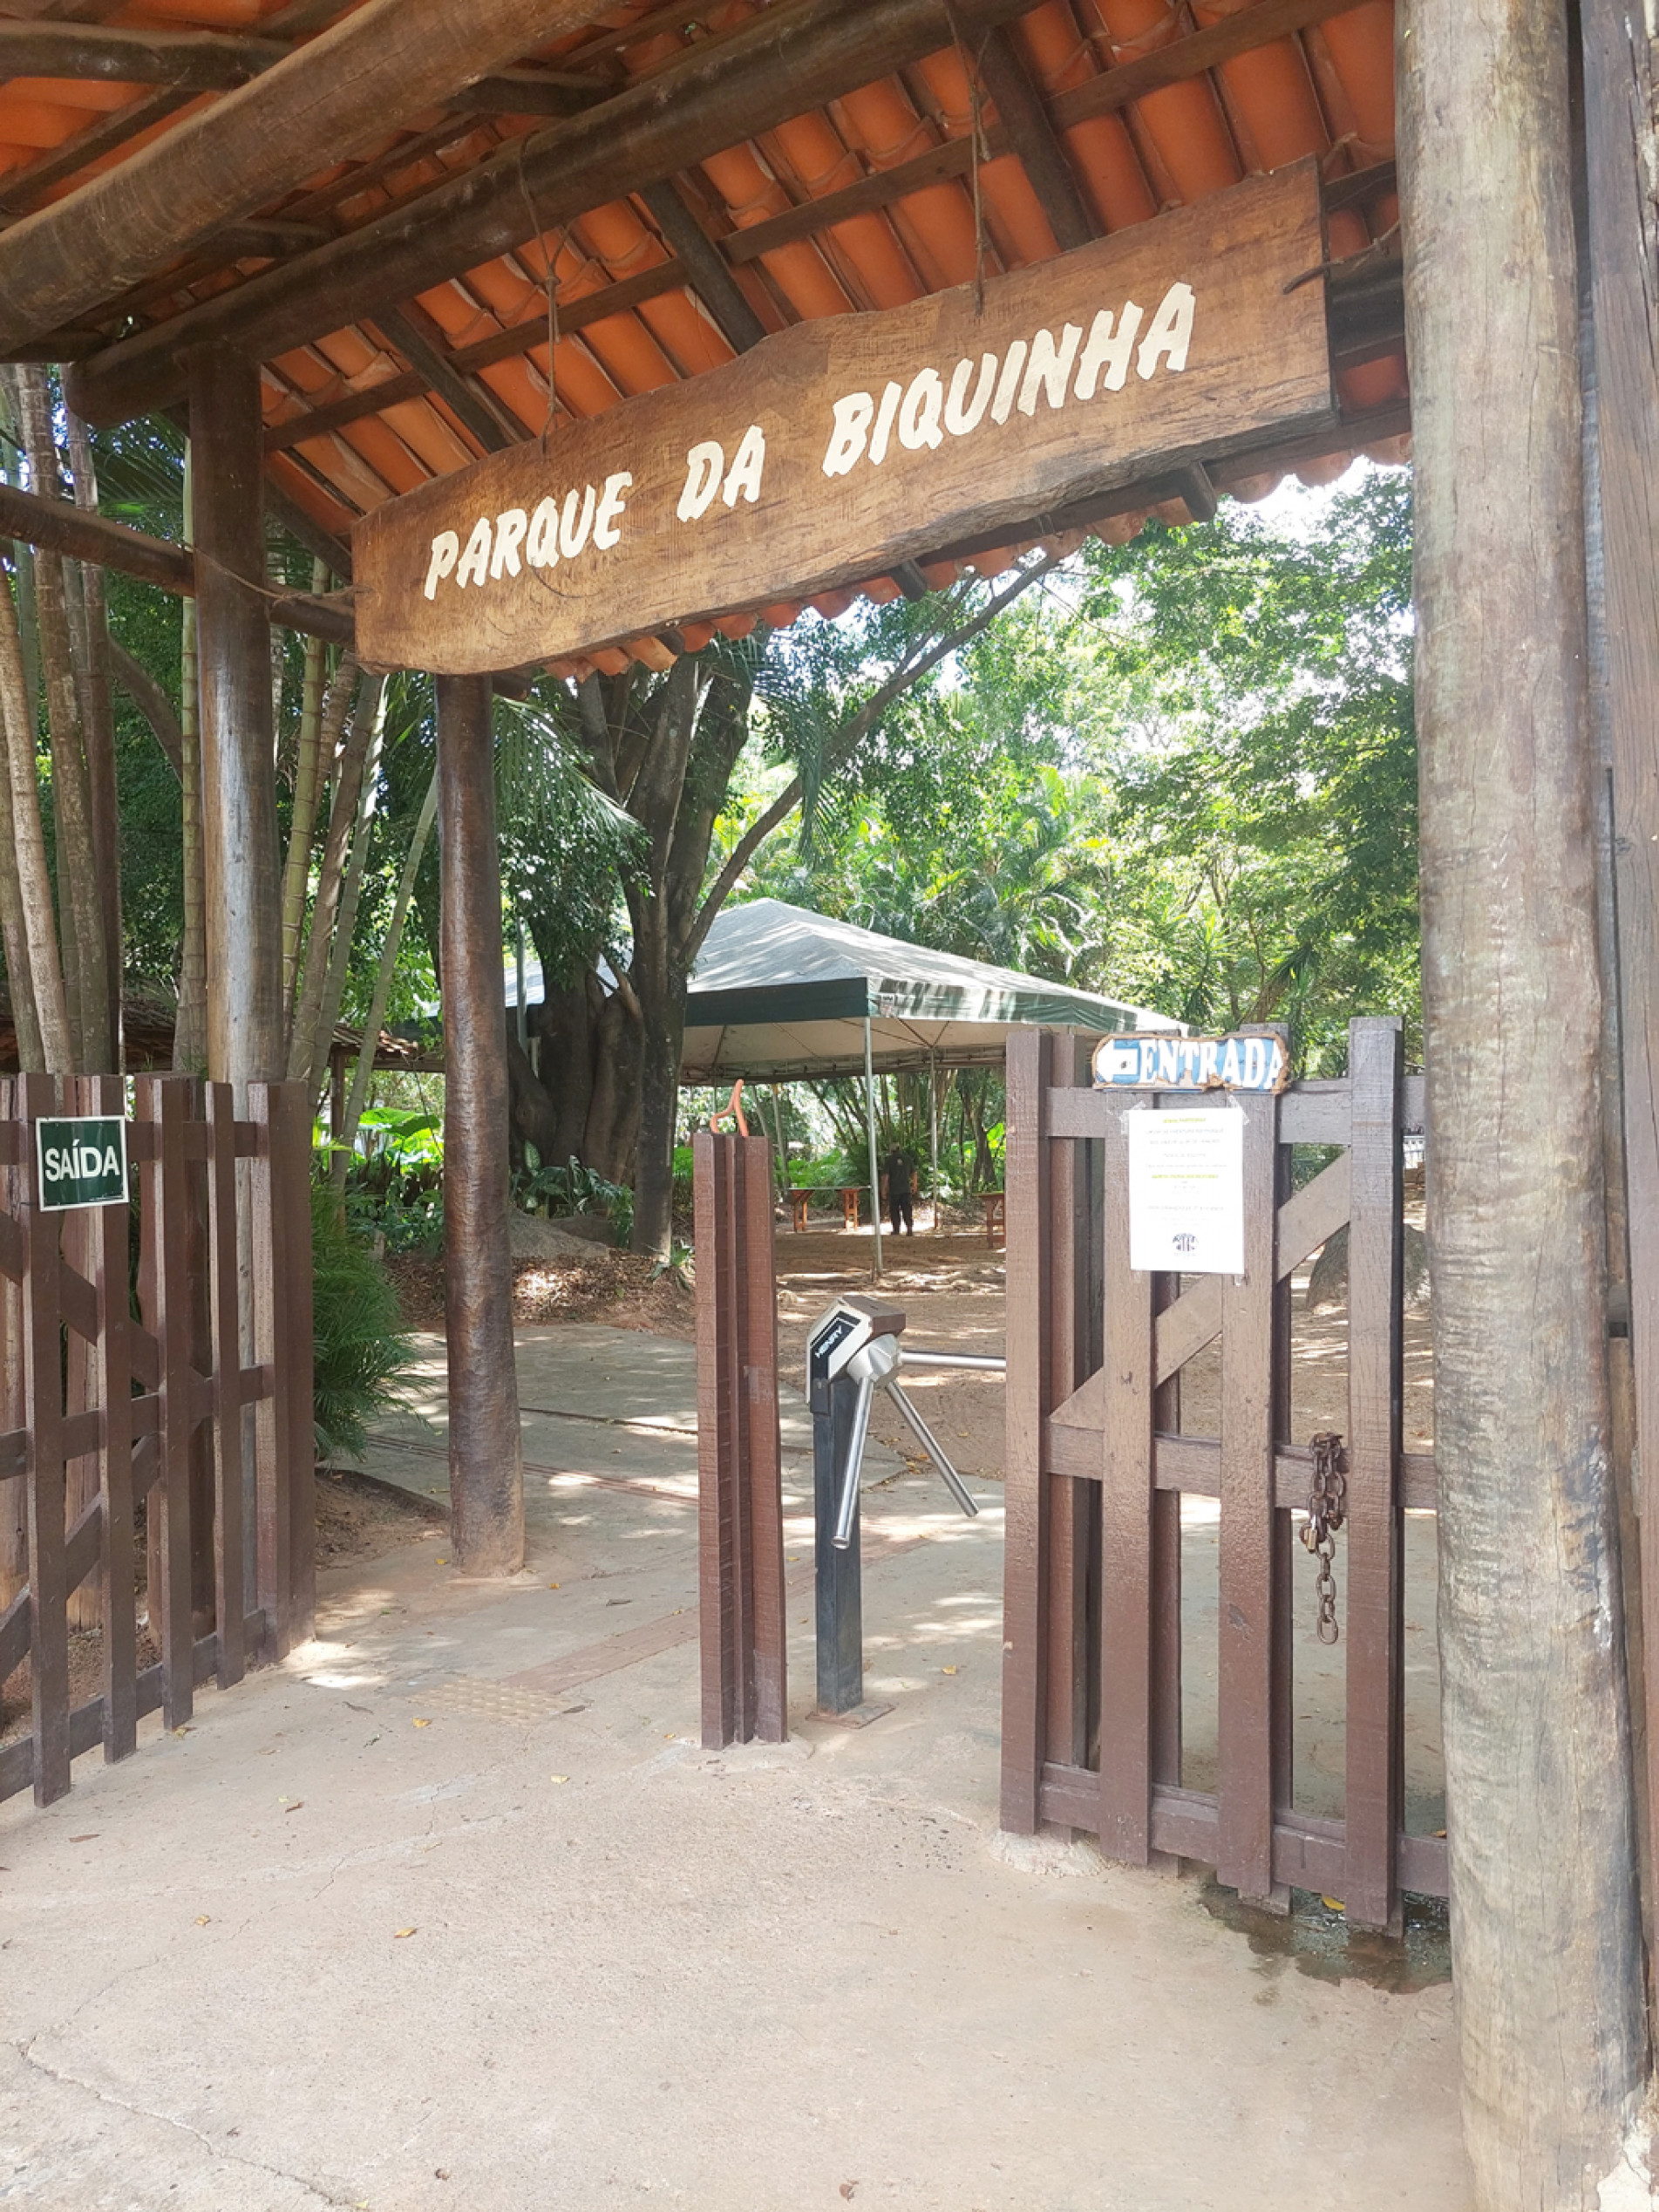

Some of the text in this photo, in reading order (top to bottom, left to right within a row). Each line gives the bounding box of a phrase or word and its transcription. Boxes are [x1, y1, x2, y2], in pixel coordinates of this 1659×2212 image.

[424, 282, 1195, 601] PARQUE DA BIQUINHA
[1139, 1038, 1283, 1089] ENTRADA
[44, 1139, 120, 1182] SAÍDA
